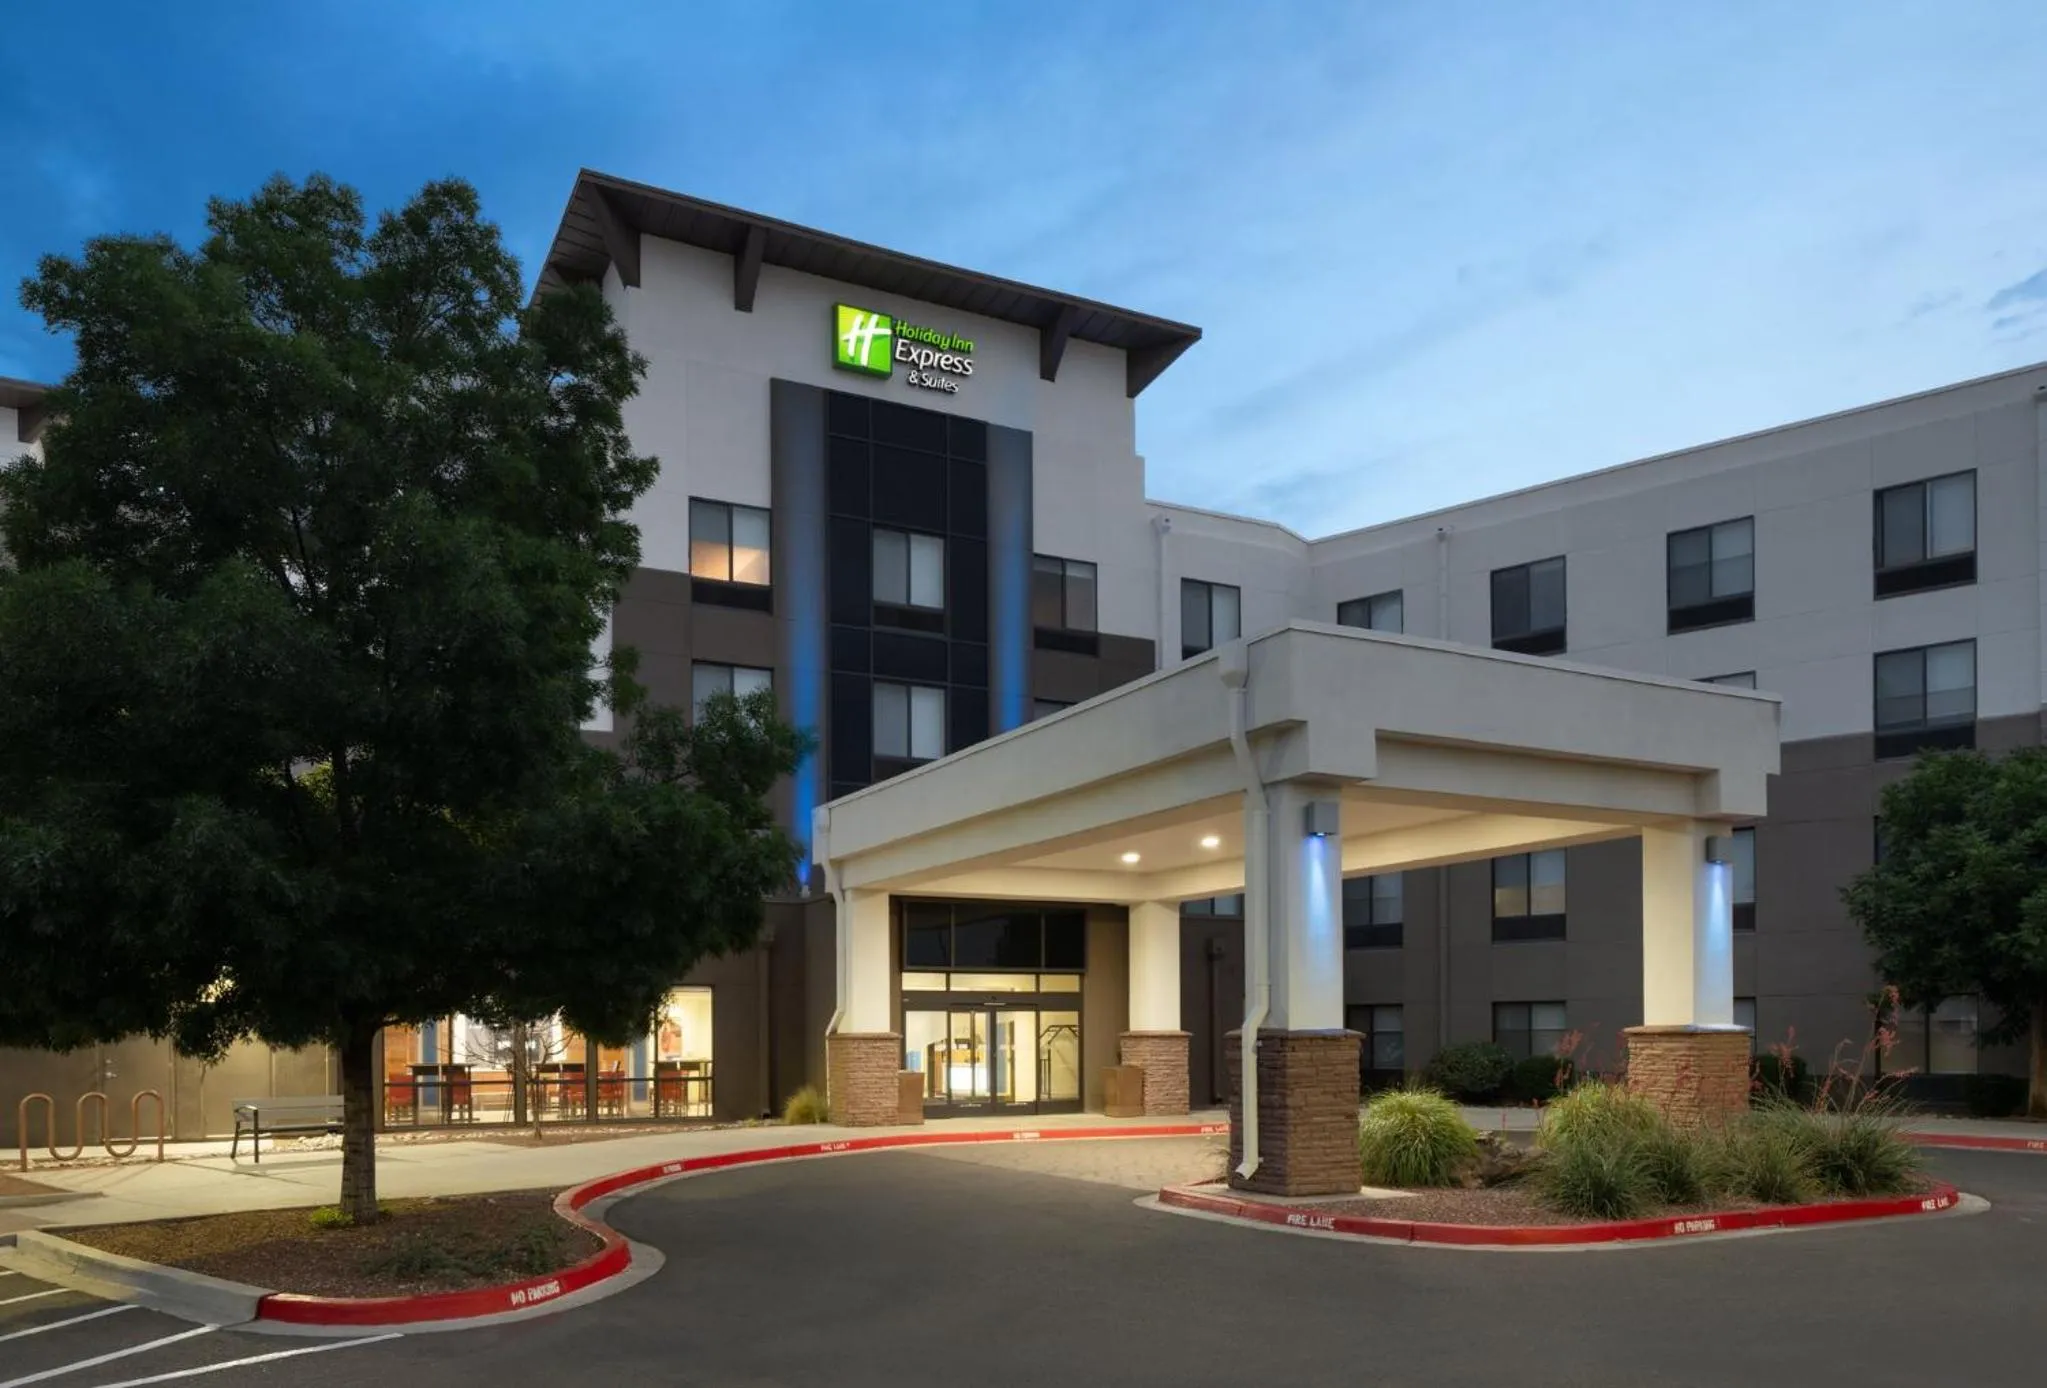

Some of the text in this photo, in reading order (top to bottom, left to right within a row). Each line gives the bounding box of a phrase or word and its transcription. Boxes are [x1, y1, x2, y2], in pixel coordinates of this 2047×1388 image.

[895, 320, 973, 351] Holiday Inn
[895, 339, 973, 375] Express
[909, 370, 959, 392] & Suites
[1286, 1214, 1335, 1229] FIRE LANE
[511, 1280, 560, 1306] NO PARKING
